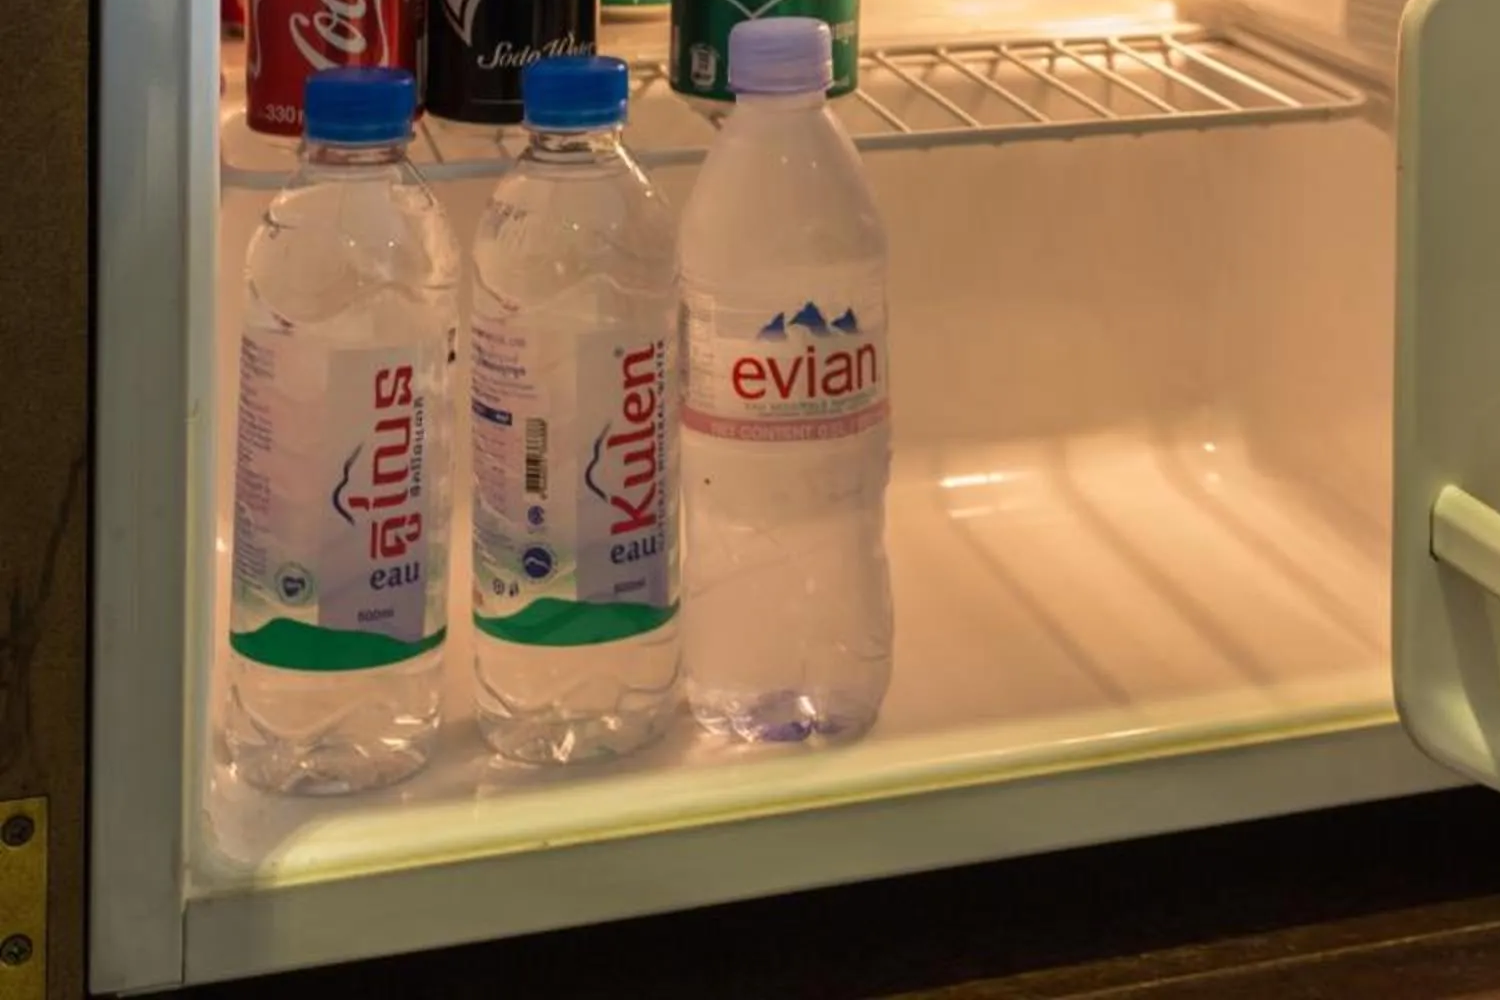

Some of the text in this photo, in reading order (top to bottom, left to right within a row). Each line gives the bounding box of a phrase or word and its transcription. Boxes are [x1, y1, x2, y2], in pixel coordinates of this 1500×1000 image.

[731, 342, 877, 400] evian
[606, 342, 658, 536] Kulen
[610, 536, 659, 565] eau
[369, 561, 421, 590] eau
